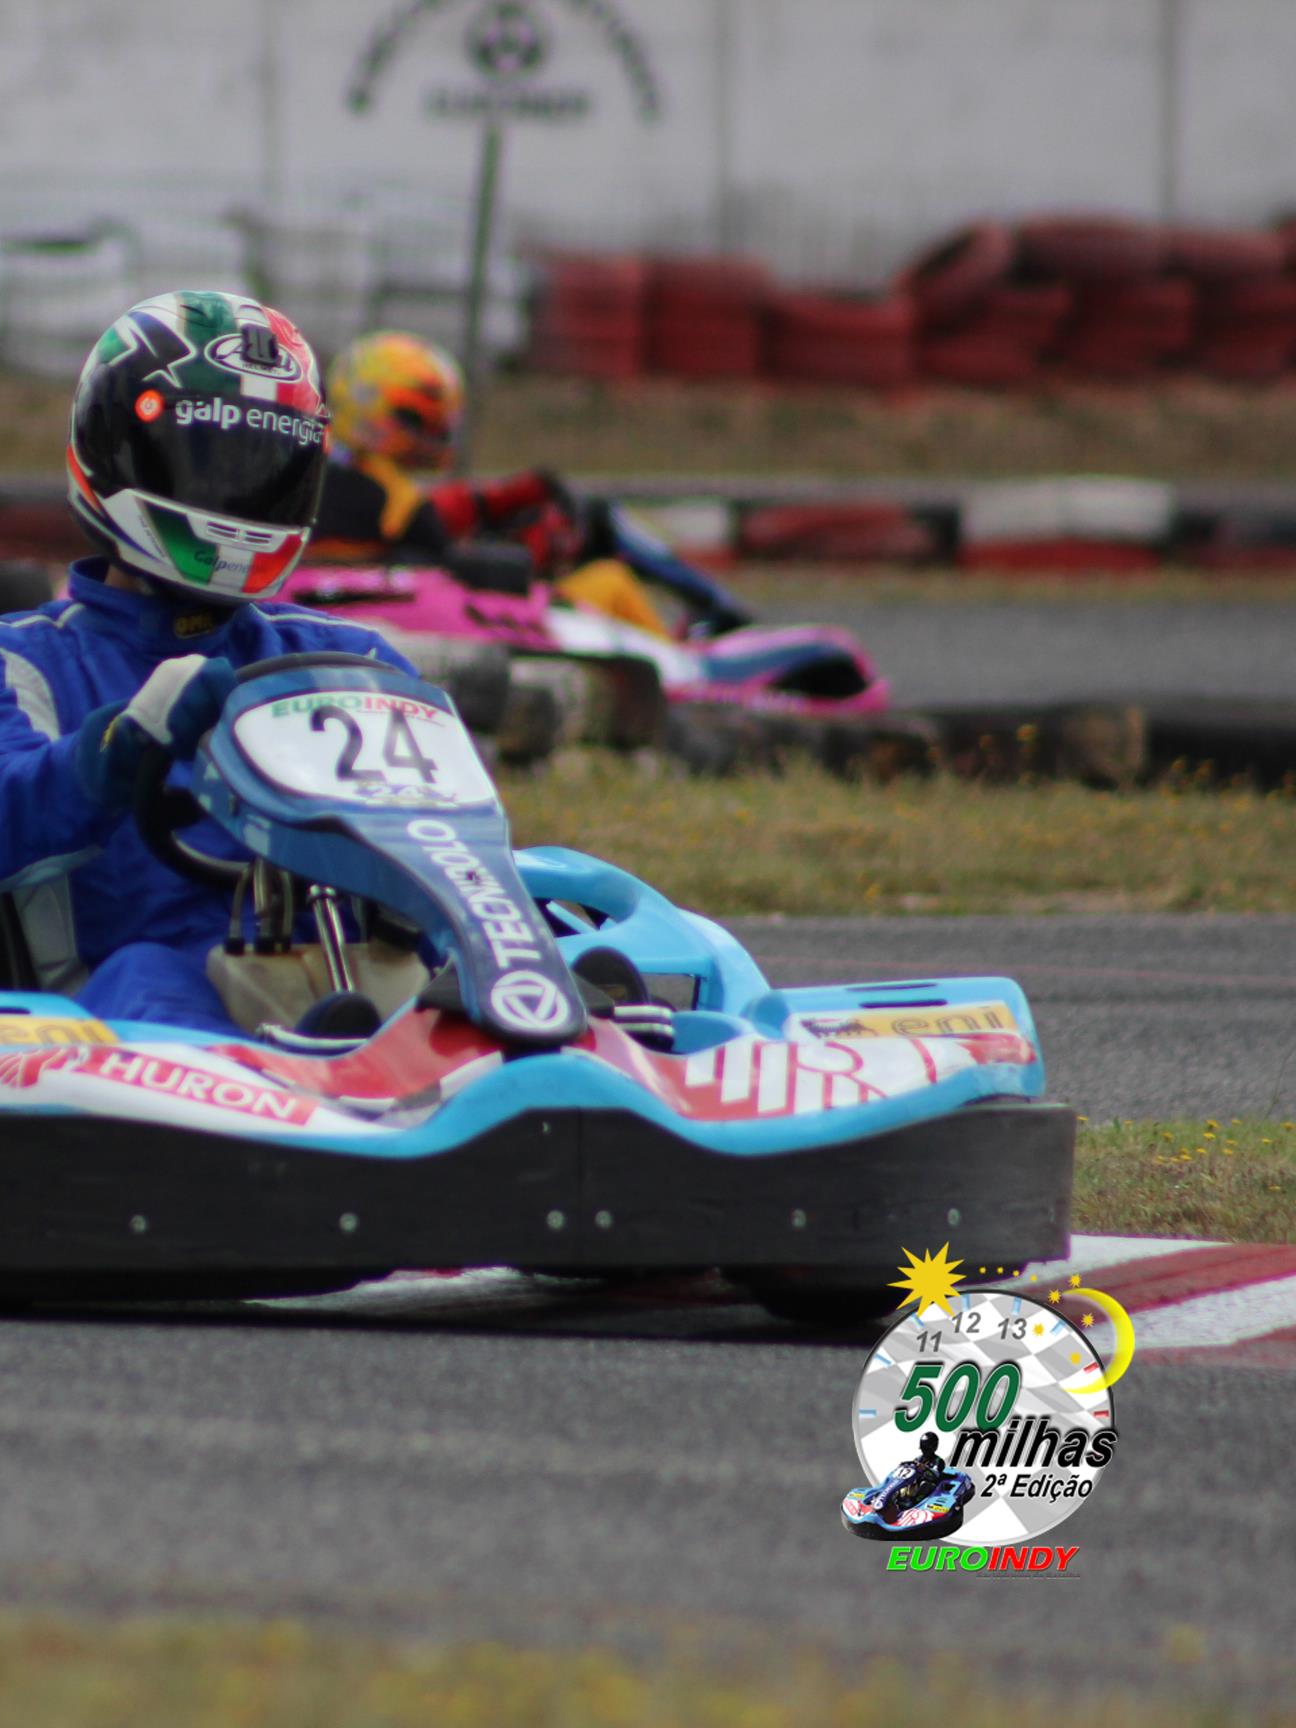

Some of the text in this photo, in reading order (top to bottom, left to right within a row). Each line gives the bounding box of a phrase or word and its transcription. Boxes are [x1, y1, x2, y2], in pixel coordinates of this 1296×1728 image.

[175, 397, 324, 446] galp energia
[271, 696, 438, 719] EUROINDY
[309, 704, 439, 785] 24
[406, 819, 543, 969] TECNIROLO
[891, 1005, 1005, 1037] eni
[99, 1050, 299, 1121] HURON
